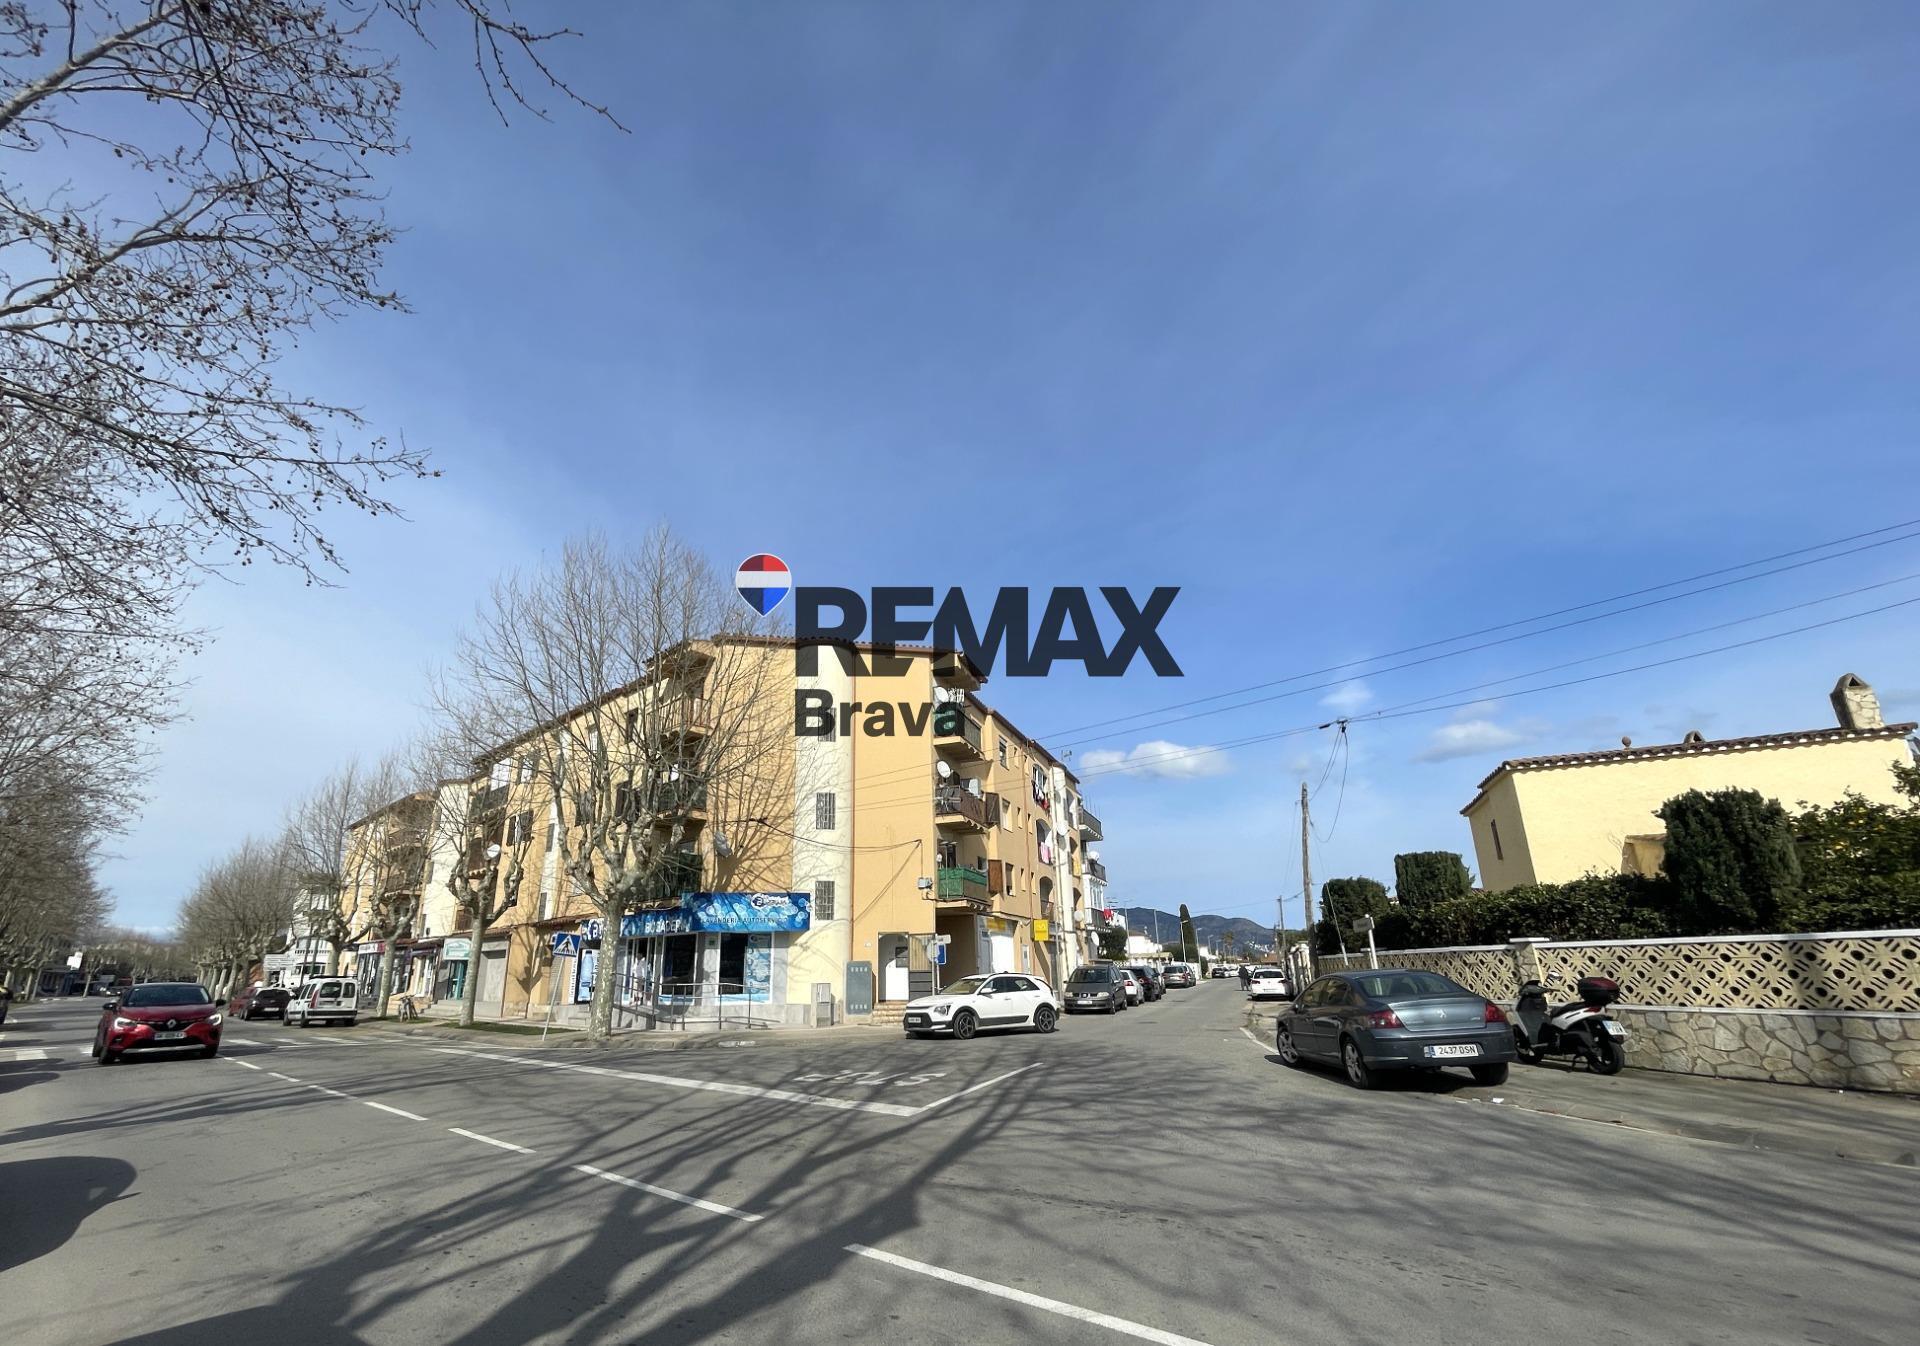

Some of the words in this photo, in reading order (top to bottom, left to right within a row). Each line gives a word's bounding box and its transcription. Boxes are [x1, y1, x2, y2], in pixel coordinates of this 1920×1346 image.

[702, 917, 740, 925] LAVANDERI
[1438, 1046, 1457, 1055] 2437
[1459, 1045, 1476, 1054] DSN
